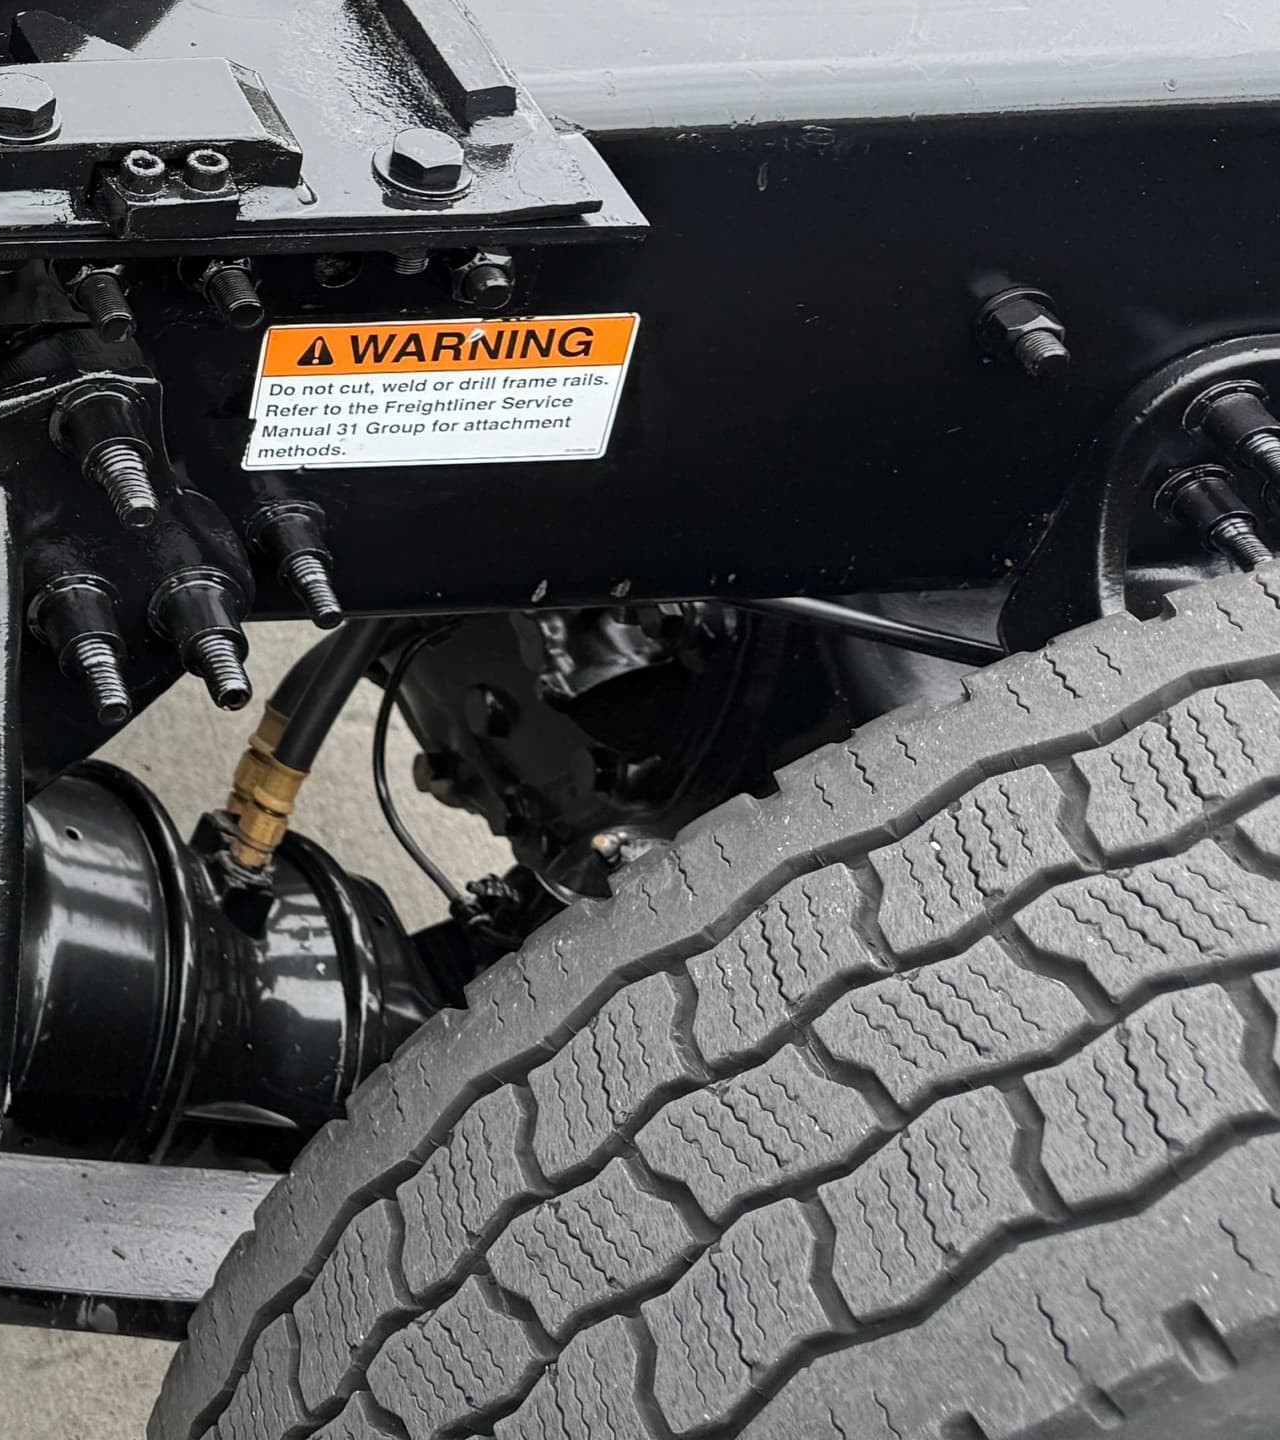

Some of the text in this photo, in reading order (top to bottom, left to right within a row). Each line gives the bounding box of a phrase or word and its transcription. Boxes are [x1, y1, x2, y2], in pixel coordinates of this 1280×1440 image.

[349, 327, 594, 364] WARNING
[269, 374, 609, 396] Do not cut, weld or drill frame rails.
[265, 395, 574, 417] Refer to the Freightliner Service
[262, 416, 572, 438] Manual 31 Group for attachment
[258, 443, 346, 458] methods.
